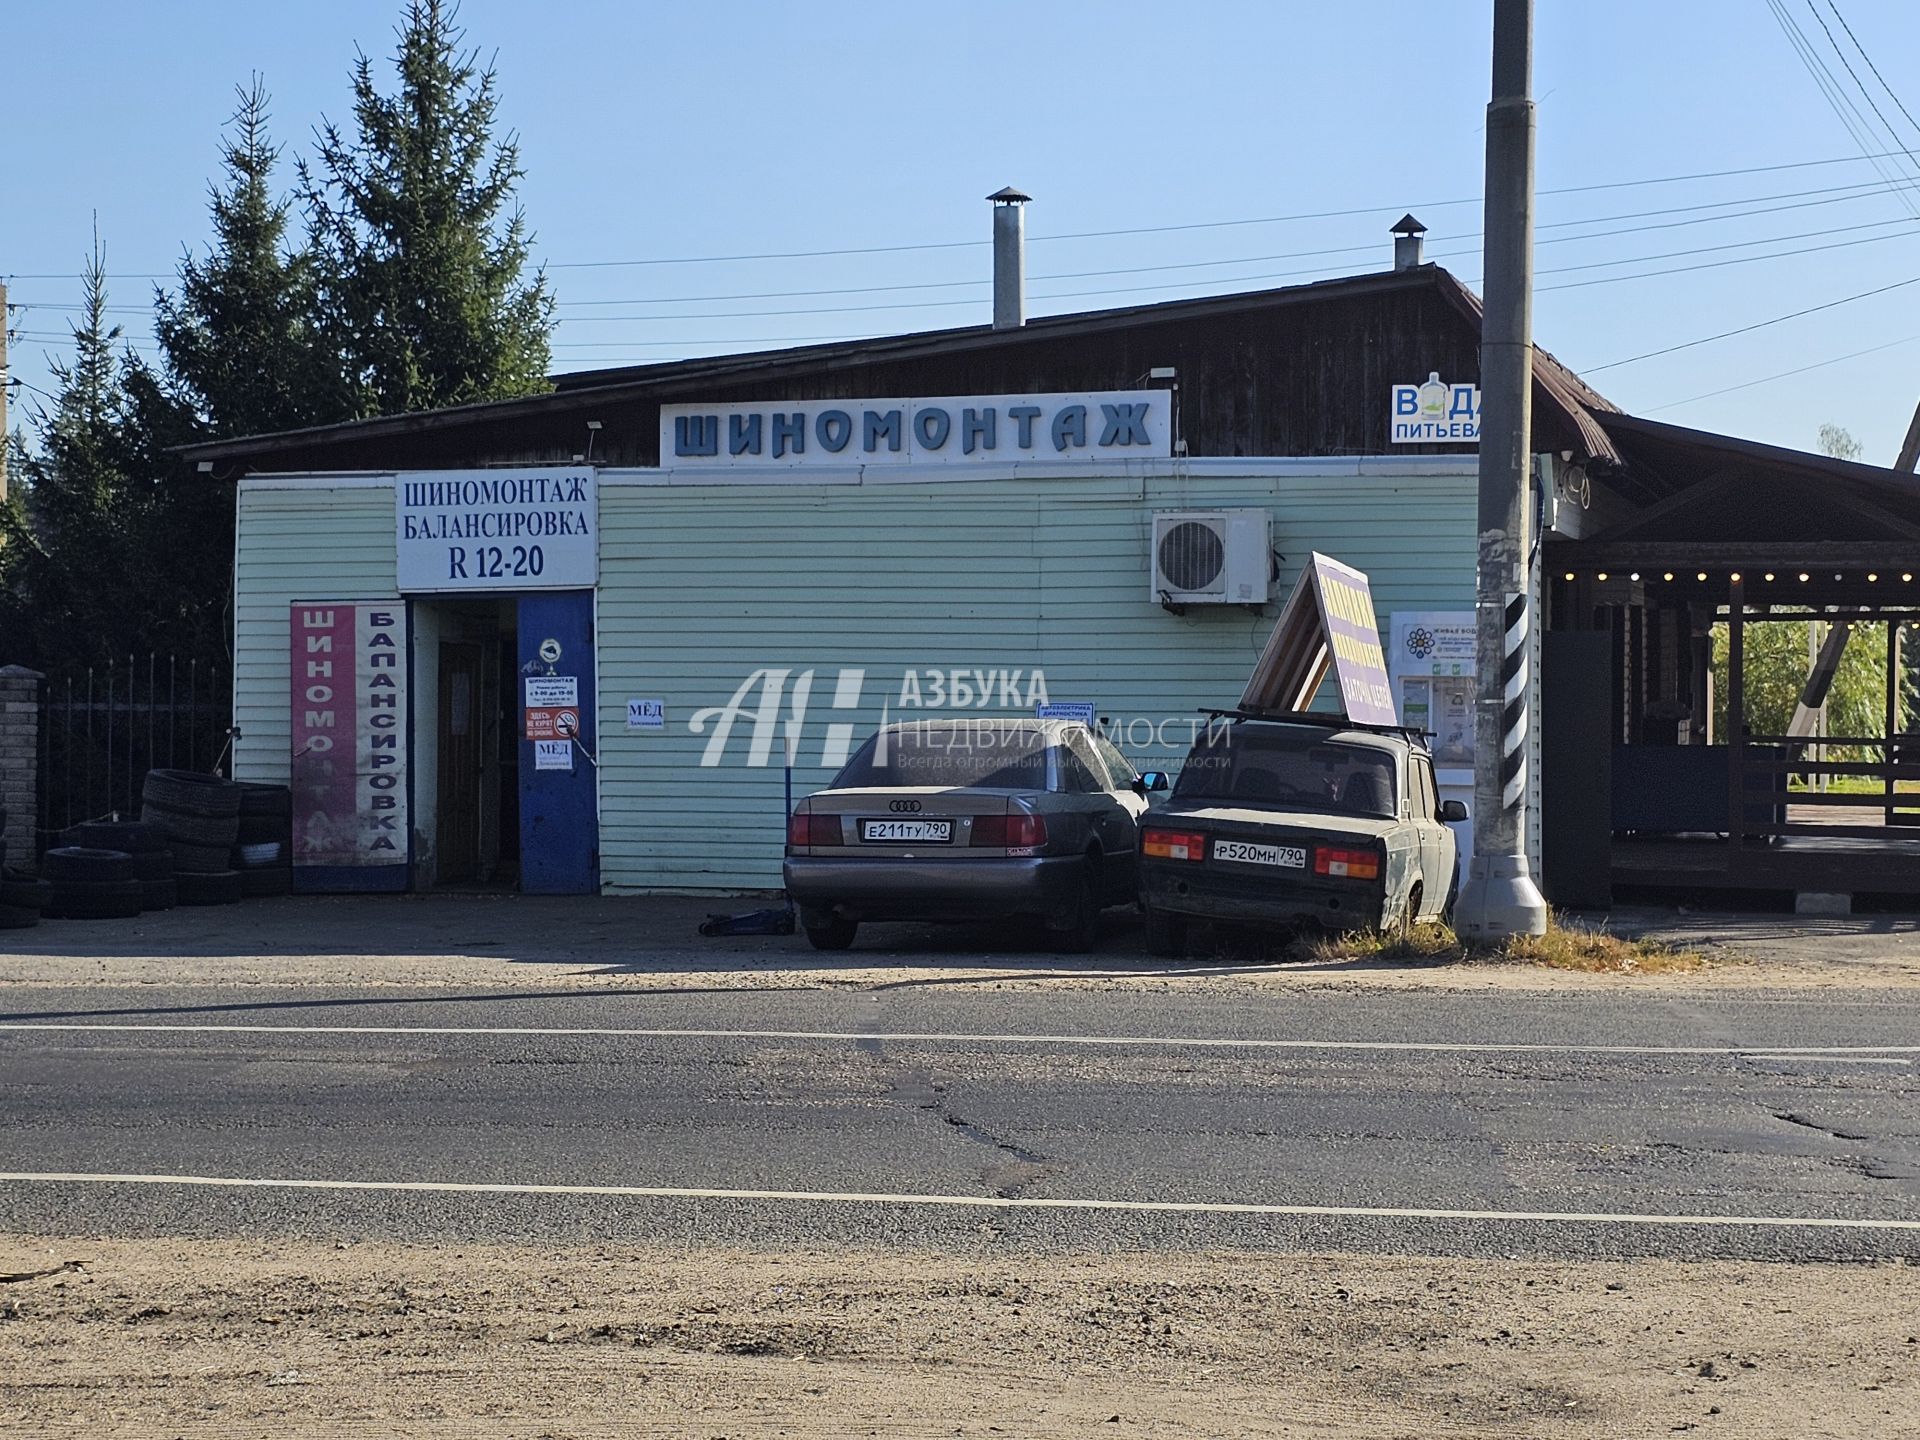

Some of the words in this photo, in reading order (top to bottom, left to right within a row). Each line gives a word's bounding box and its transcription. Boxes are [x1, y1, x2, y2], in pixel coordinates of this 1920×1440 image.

[675, 403, 1151, 459] ШИНОМОНТАЖ
[405, 477, 588, 507] ШИНОМОНТАЖ
[403, 510, 589, 540] БАЛАНСИРОВКА
[449, 547, 468, 579] R
[476, 545, 544, 578] 12-20
[630, 701, 662, 717] МЁД
[303, 611, 335, 852] ШИНОМОНТАЖ
[368, 613, 397, 851] БАЛАНСИРОВКА
[539, 741, 569, 755] МЁД
[925, 823, 947, 834] 790
[1280, 848, 1302, 860] 790
